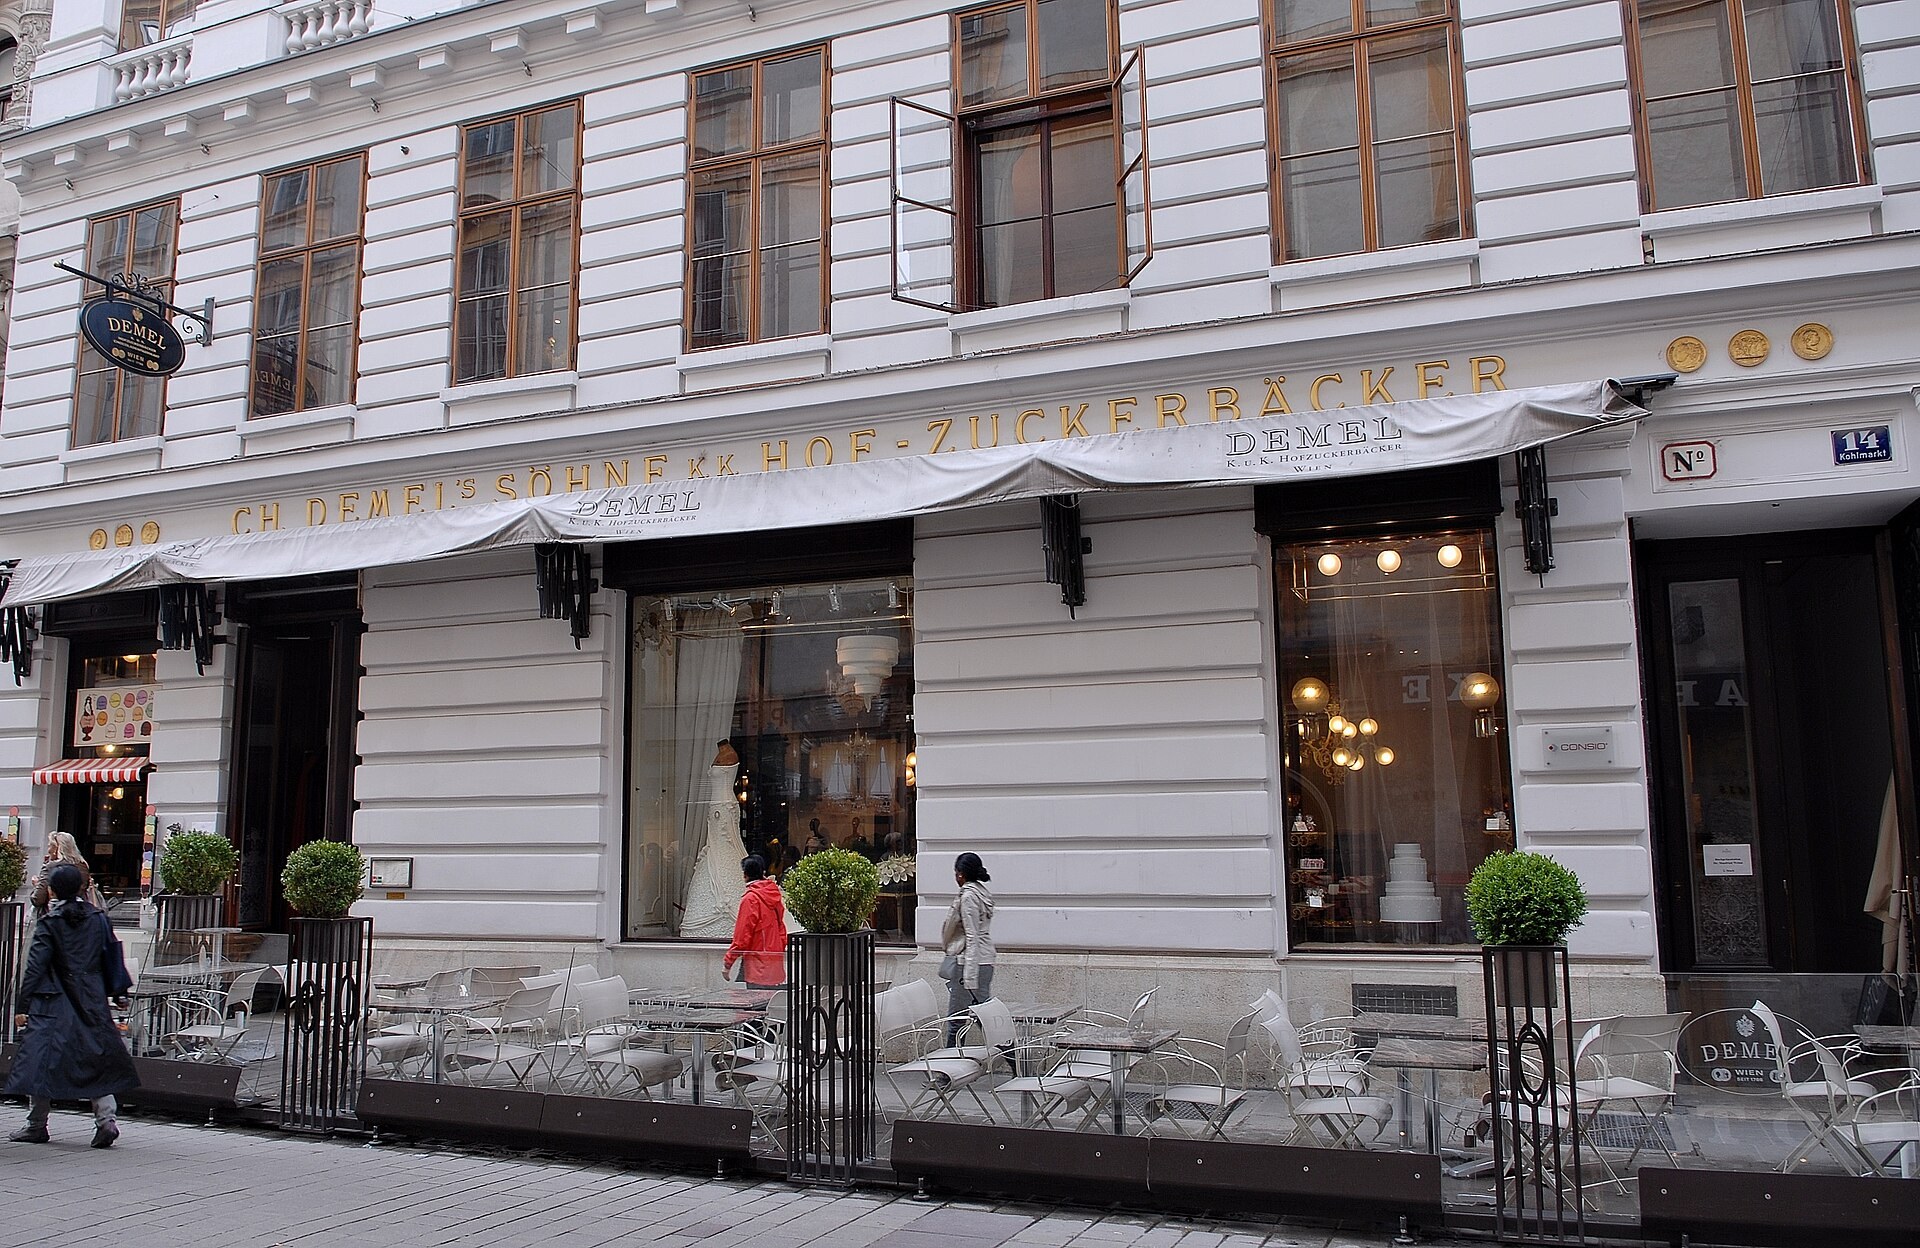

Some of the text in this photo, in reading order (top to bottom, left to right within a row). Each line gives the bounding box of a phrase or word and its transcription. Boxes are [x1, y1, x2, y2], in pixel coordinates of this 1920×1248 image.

[107, 317, 167, 350] DEMEL
[127, 351, 145, 362] WIEN
[1225, 416, 1402, 456] DEMEL
[1841, 430, 1880, 451] 14
[1839, 449, 1887, 461] Kohlmarkt
[494, 454, 668, 502] SÖHNE
[572, 490, 701, 518] DEMEL
[1734, 1069, 1764, 1077] WIEN
